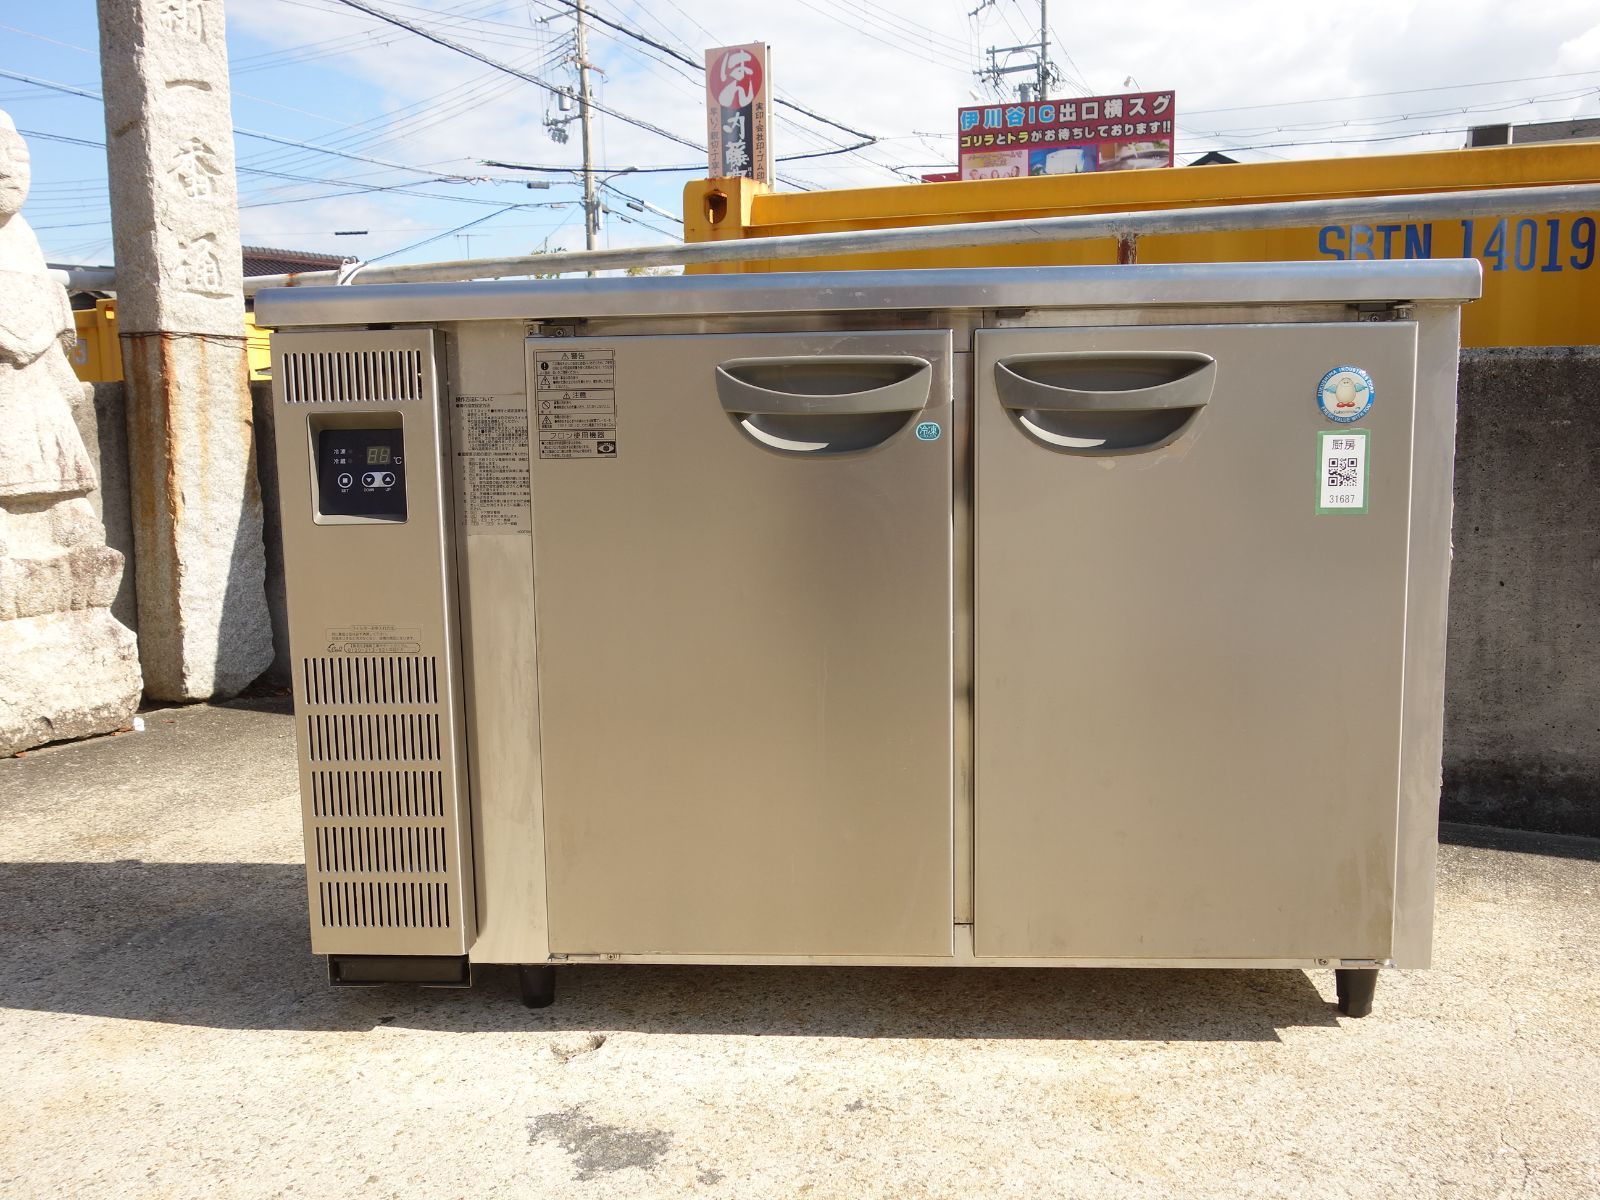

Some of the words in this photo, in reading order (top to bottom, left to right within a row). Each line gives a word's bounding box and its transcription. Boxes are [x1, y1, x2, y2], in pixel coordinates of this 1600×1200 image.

[718, 50, 754, 108] はん
[960, 95, 1172, 131] 伊川谷IC出口横スグ
[961, 121, 1171, 148] ゴリラとトラがお待ちしております!!
[1461, 217, 1596, 272] 14019
[919, 425, 937, 435] 冷凍
[1332, 439, 1356, 450] 厨房
[1329, 494, 1355, 504] 31687
